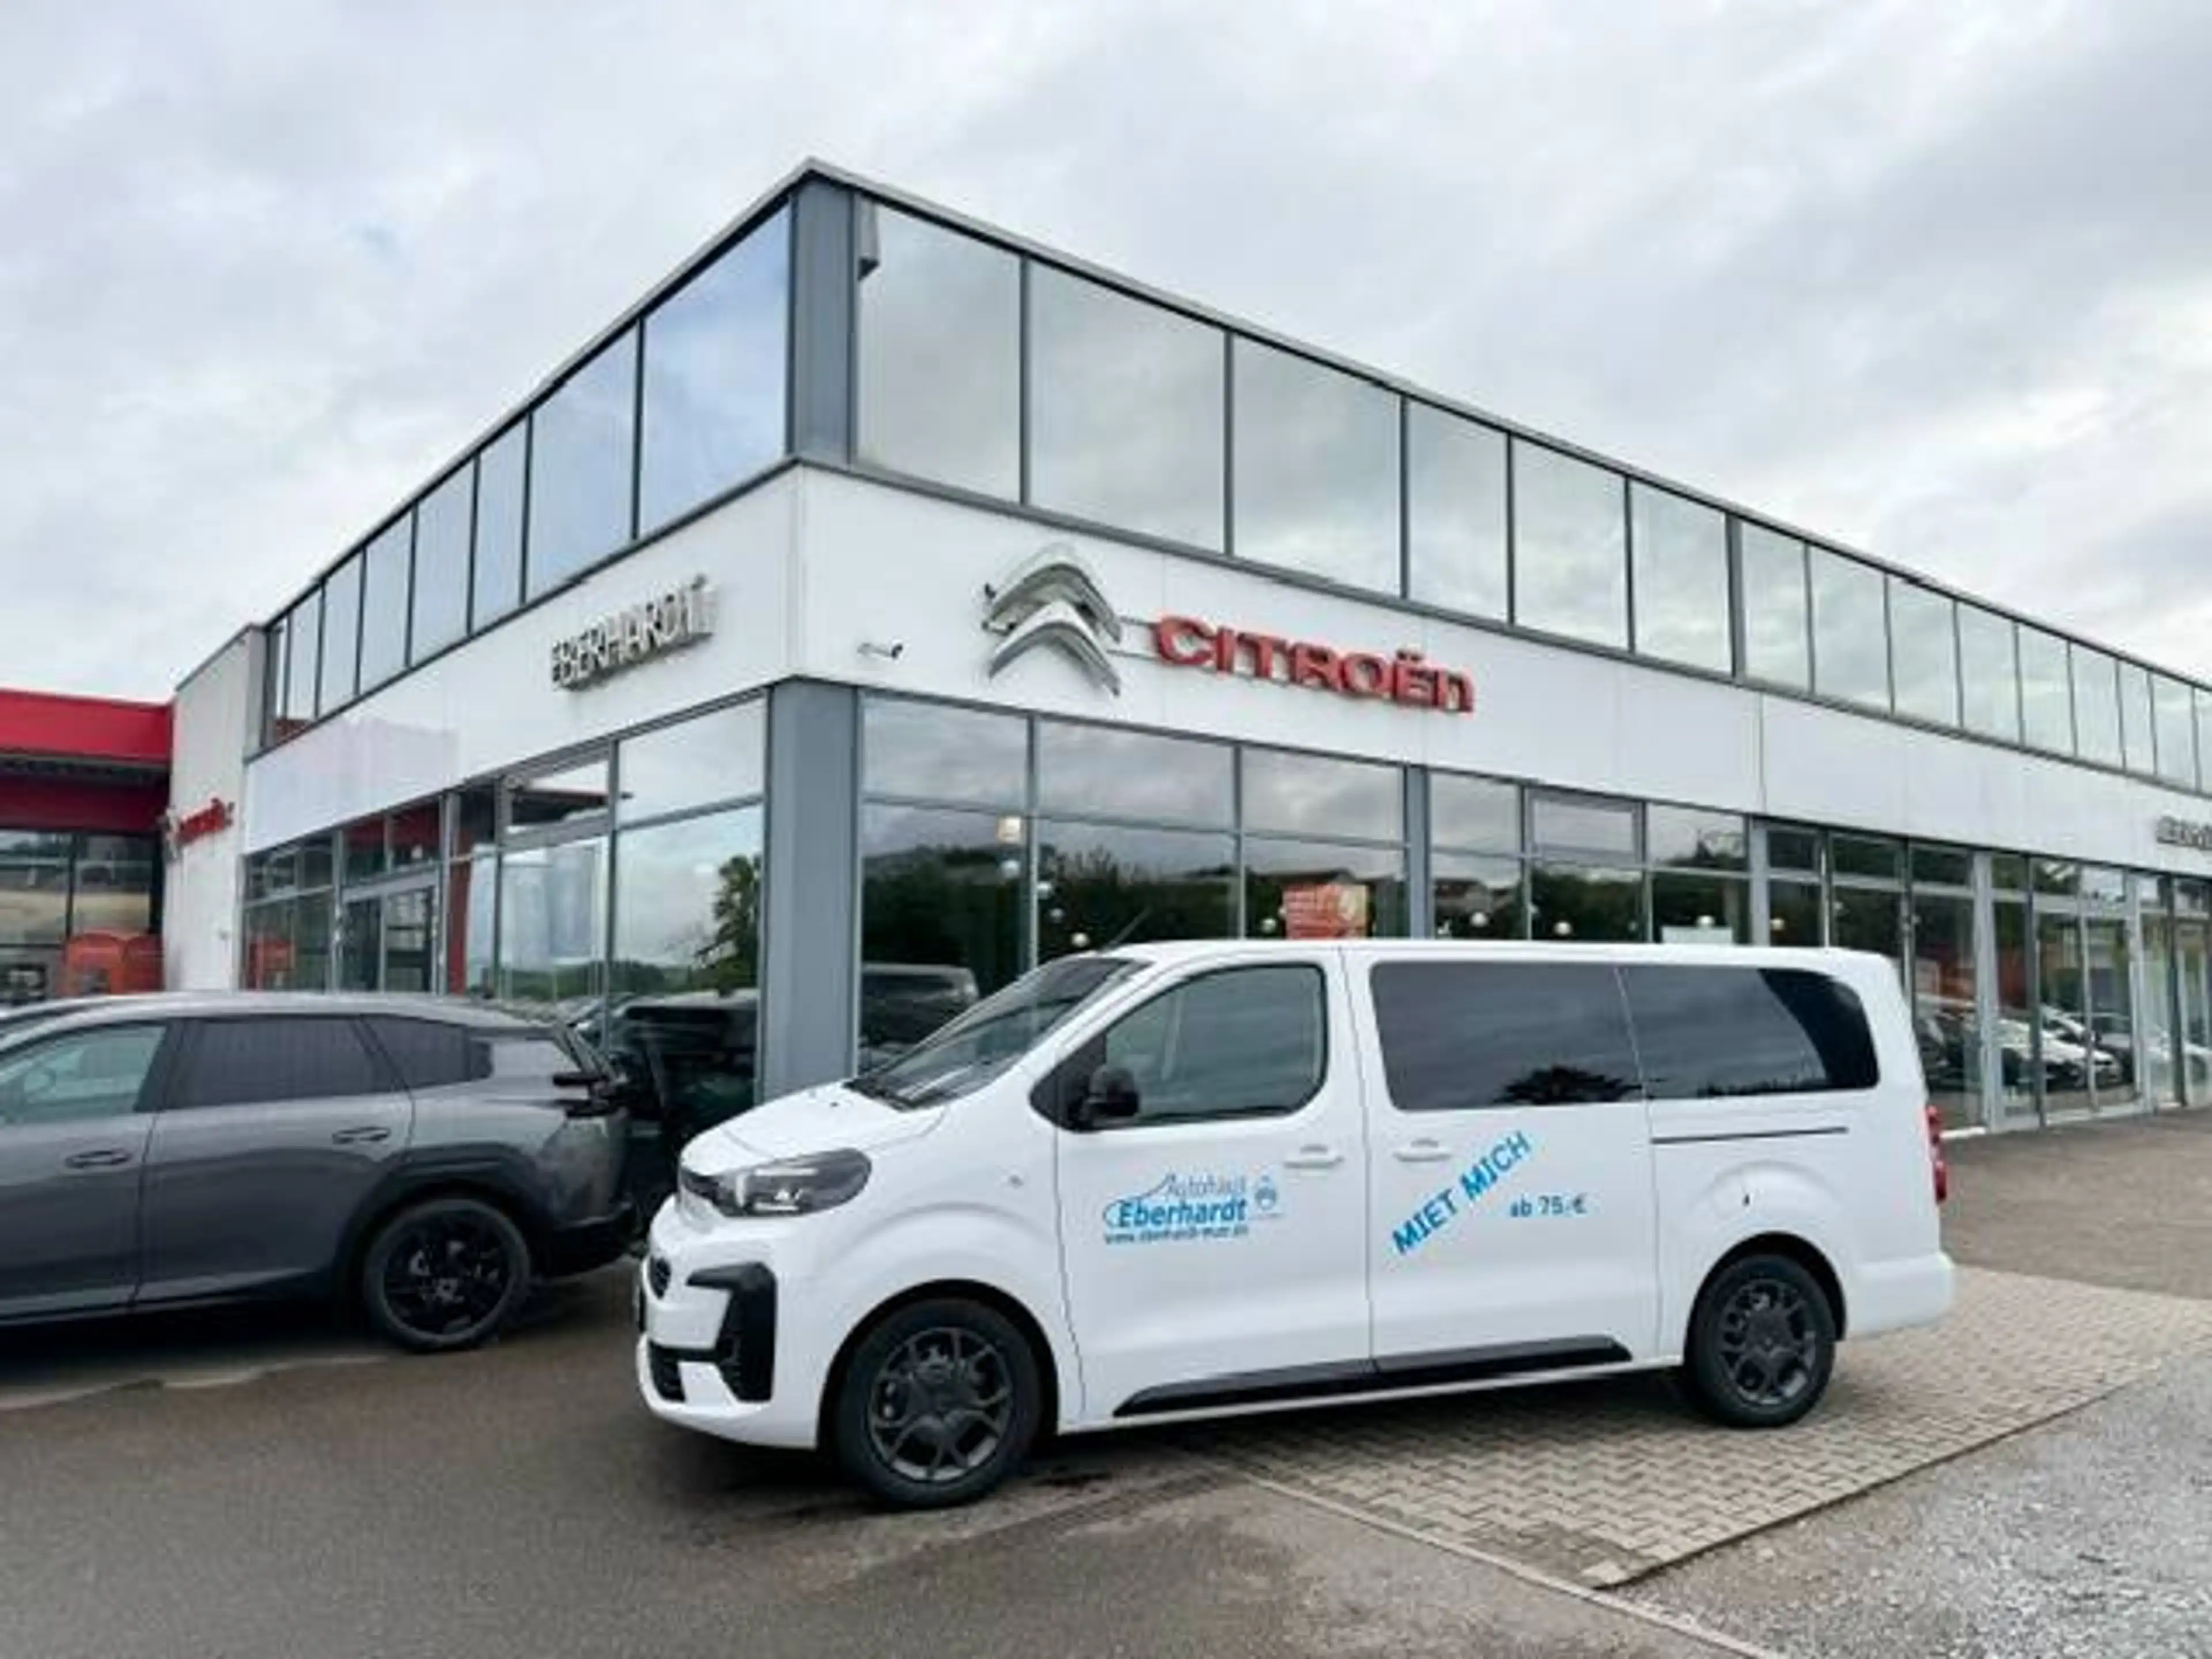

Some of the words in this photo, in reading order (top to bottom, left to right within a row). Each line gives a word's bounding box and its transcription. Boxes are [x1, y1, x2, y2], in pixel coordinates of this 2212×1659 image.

[1392, 1188, 1459, 1255] MIET
[1459, 1130, 1531, 1202] MICH
[1510, 1196, 1532, 1217] ab
[1119, 1197, 1247, 1228] Eberhardt
